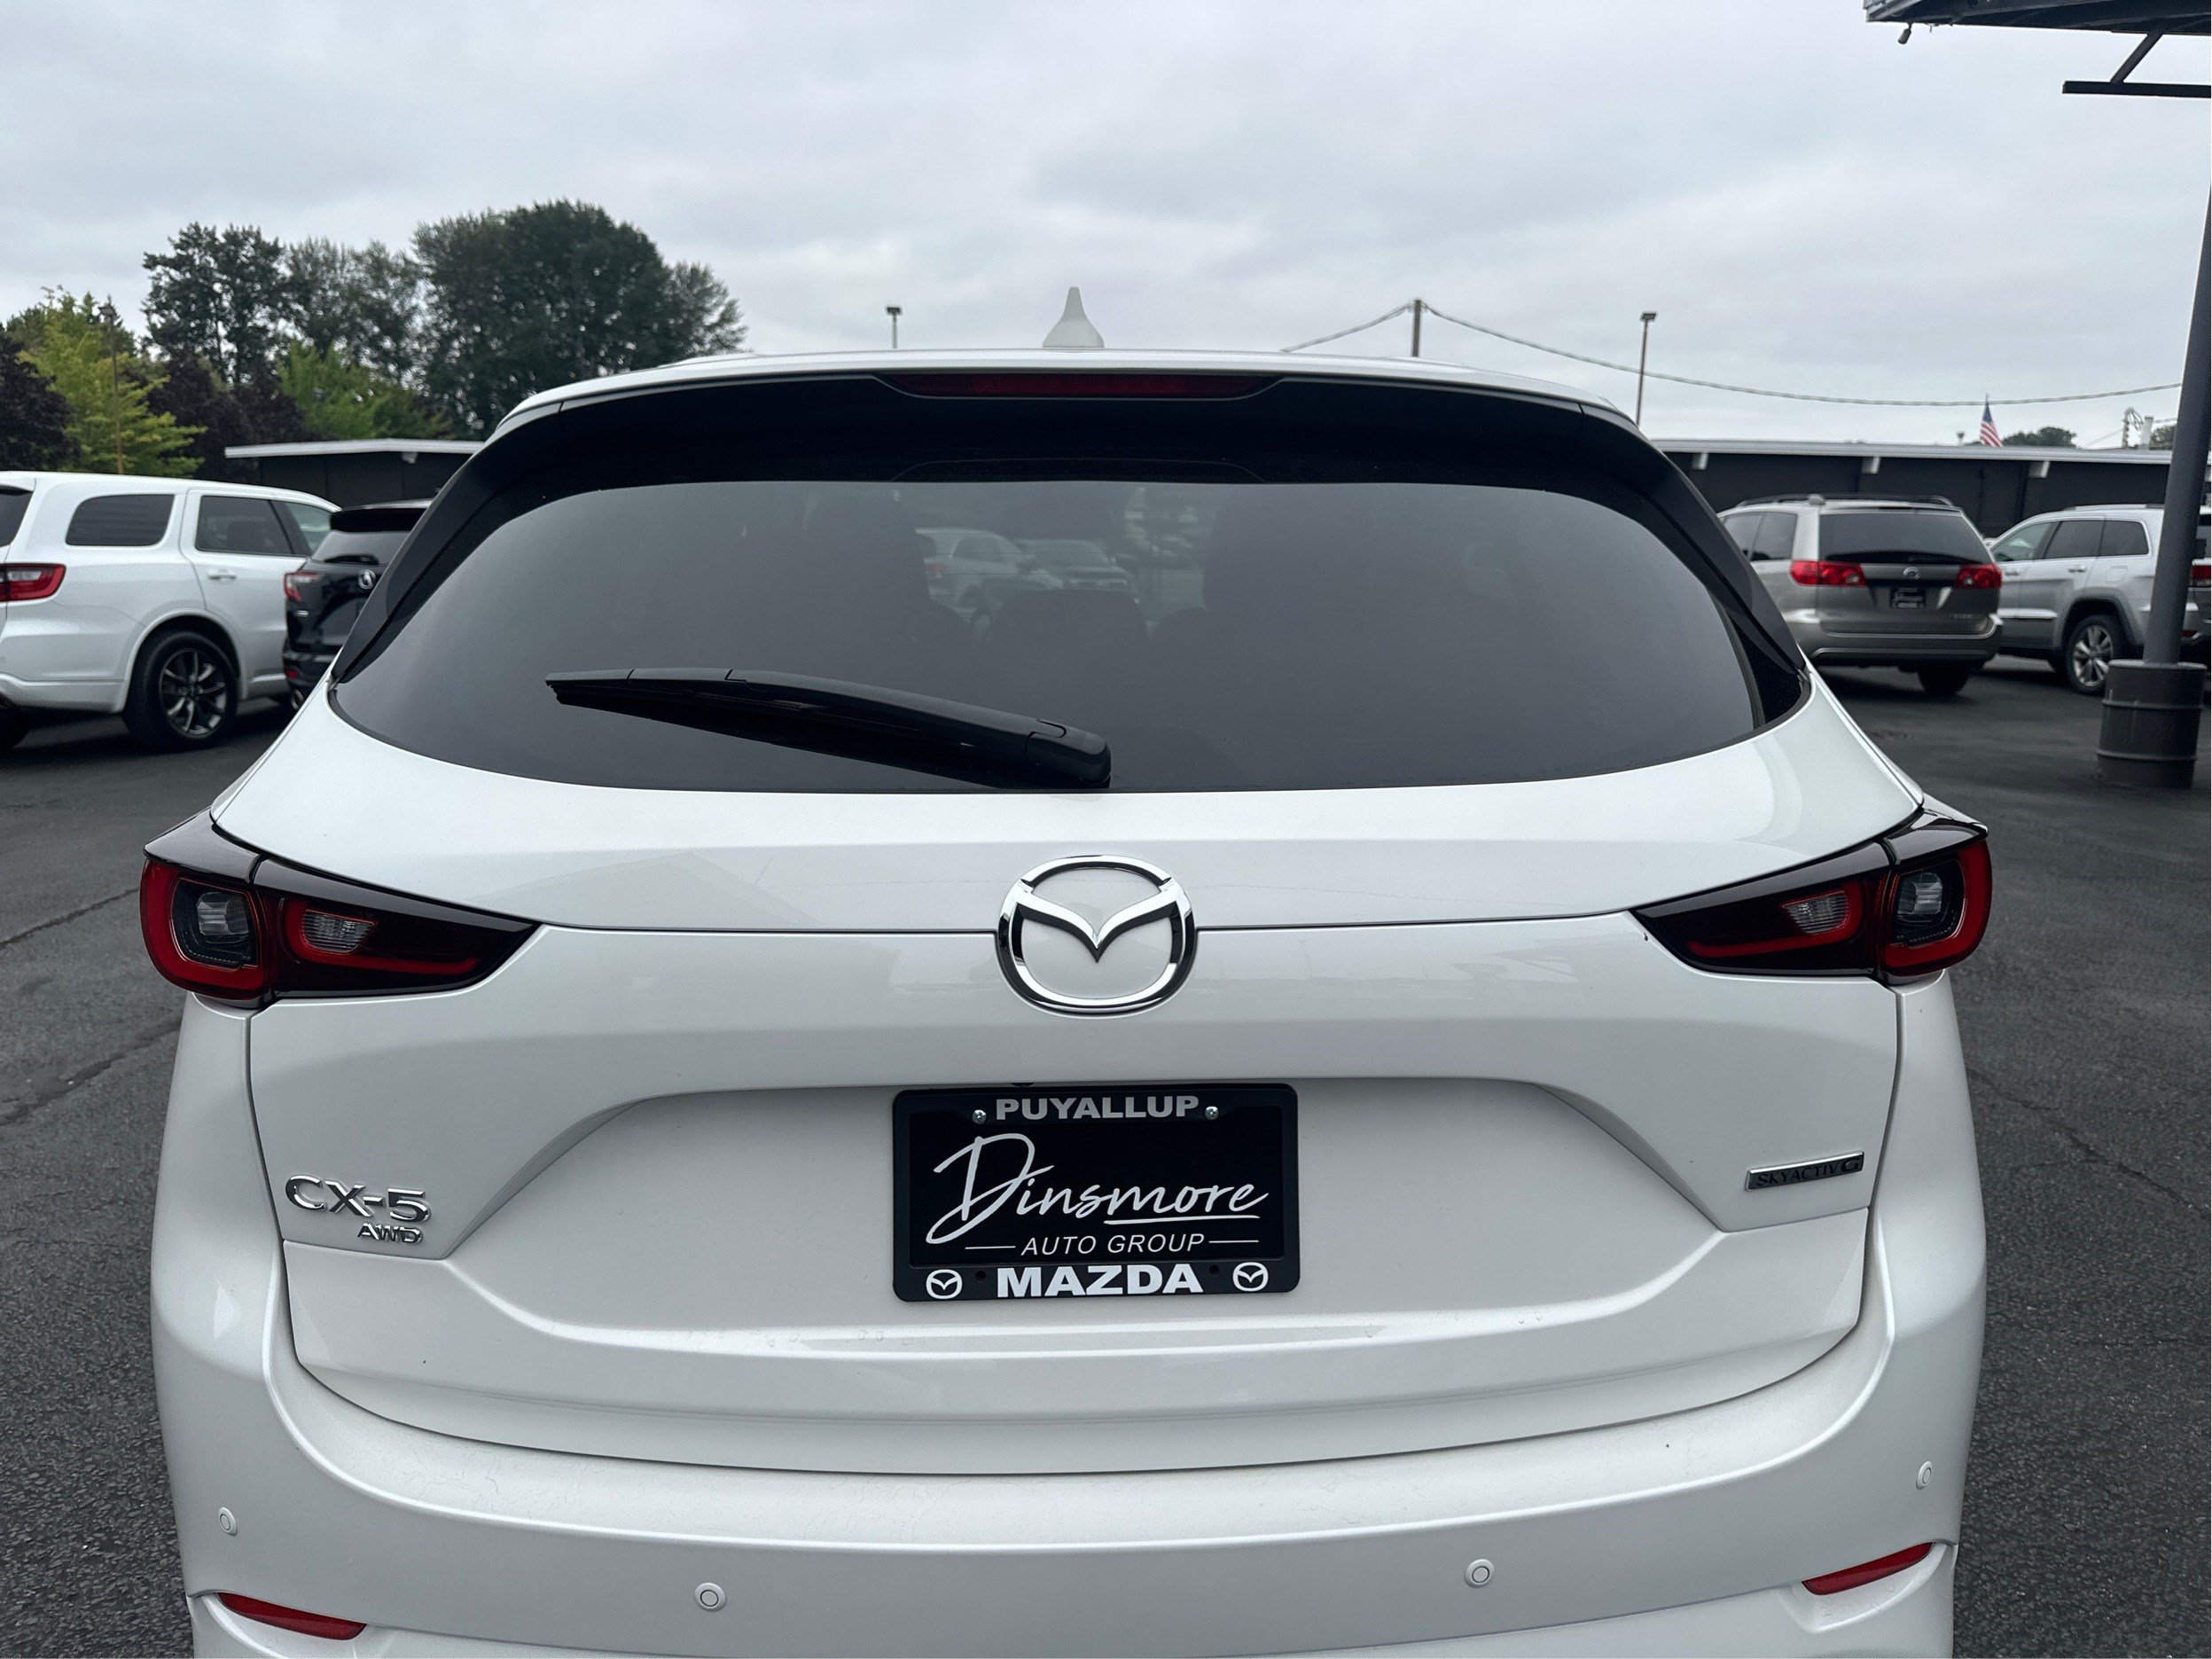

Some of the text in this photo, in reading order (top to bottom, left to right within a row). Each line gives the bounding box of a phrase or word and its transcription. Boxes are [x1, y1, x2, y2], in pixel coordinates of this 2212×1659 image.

[996, 1095, 1200, 1120] PUYALLUP
[285, 1175, 432, 1223] CX-5
[926, 1132, 1269, 1244] Dinsmore
[356, 1222, 424, 1244] AWD
[1020, 1233, 1205, 1256] AUTO GROUP
[997, 1264, 1203, 1298] MAZDA
